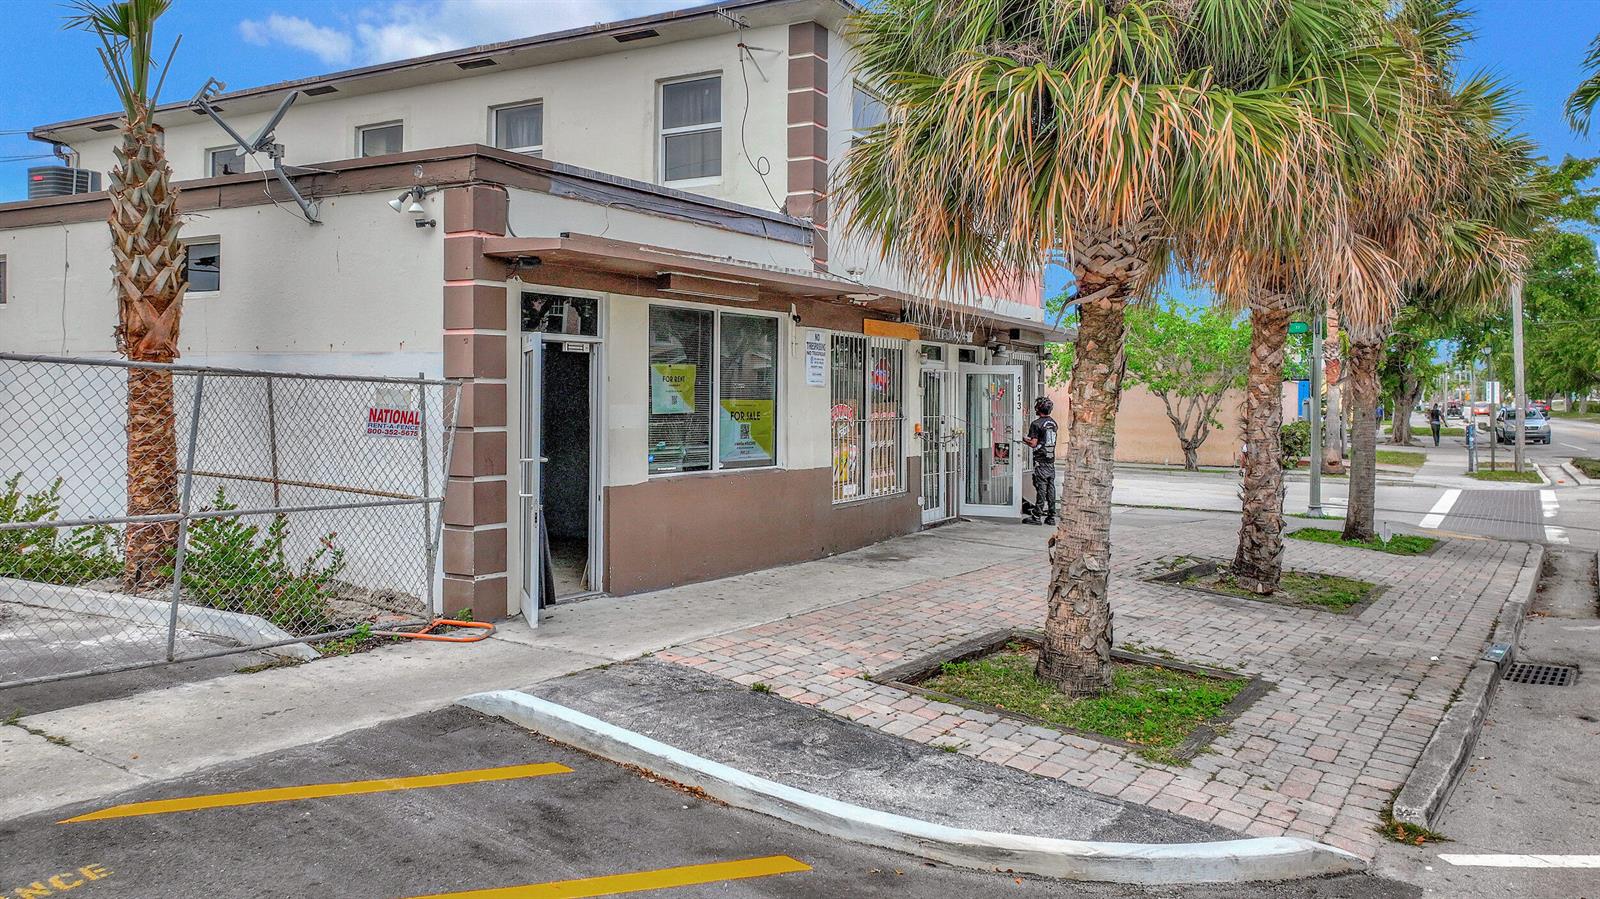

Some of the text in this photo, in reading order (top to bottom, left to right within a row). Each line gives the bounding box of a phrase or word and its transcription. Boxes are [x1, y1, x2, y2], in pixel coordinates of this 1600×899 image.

[368, 407, 420, 425] NATIONAL
[731, 411, 761, 421] FOR SALE
